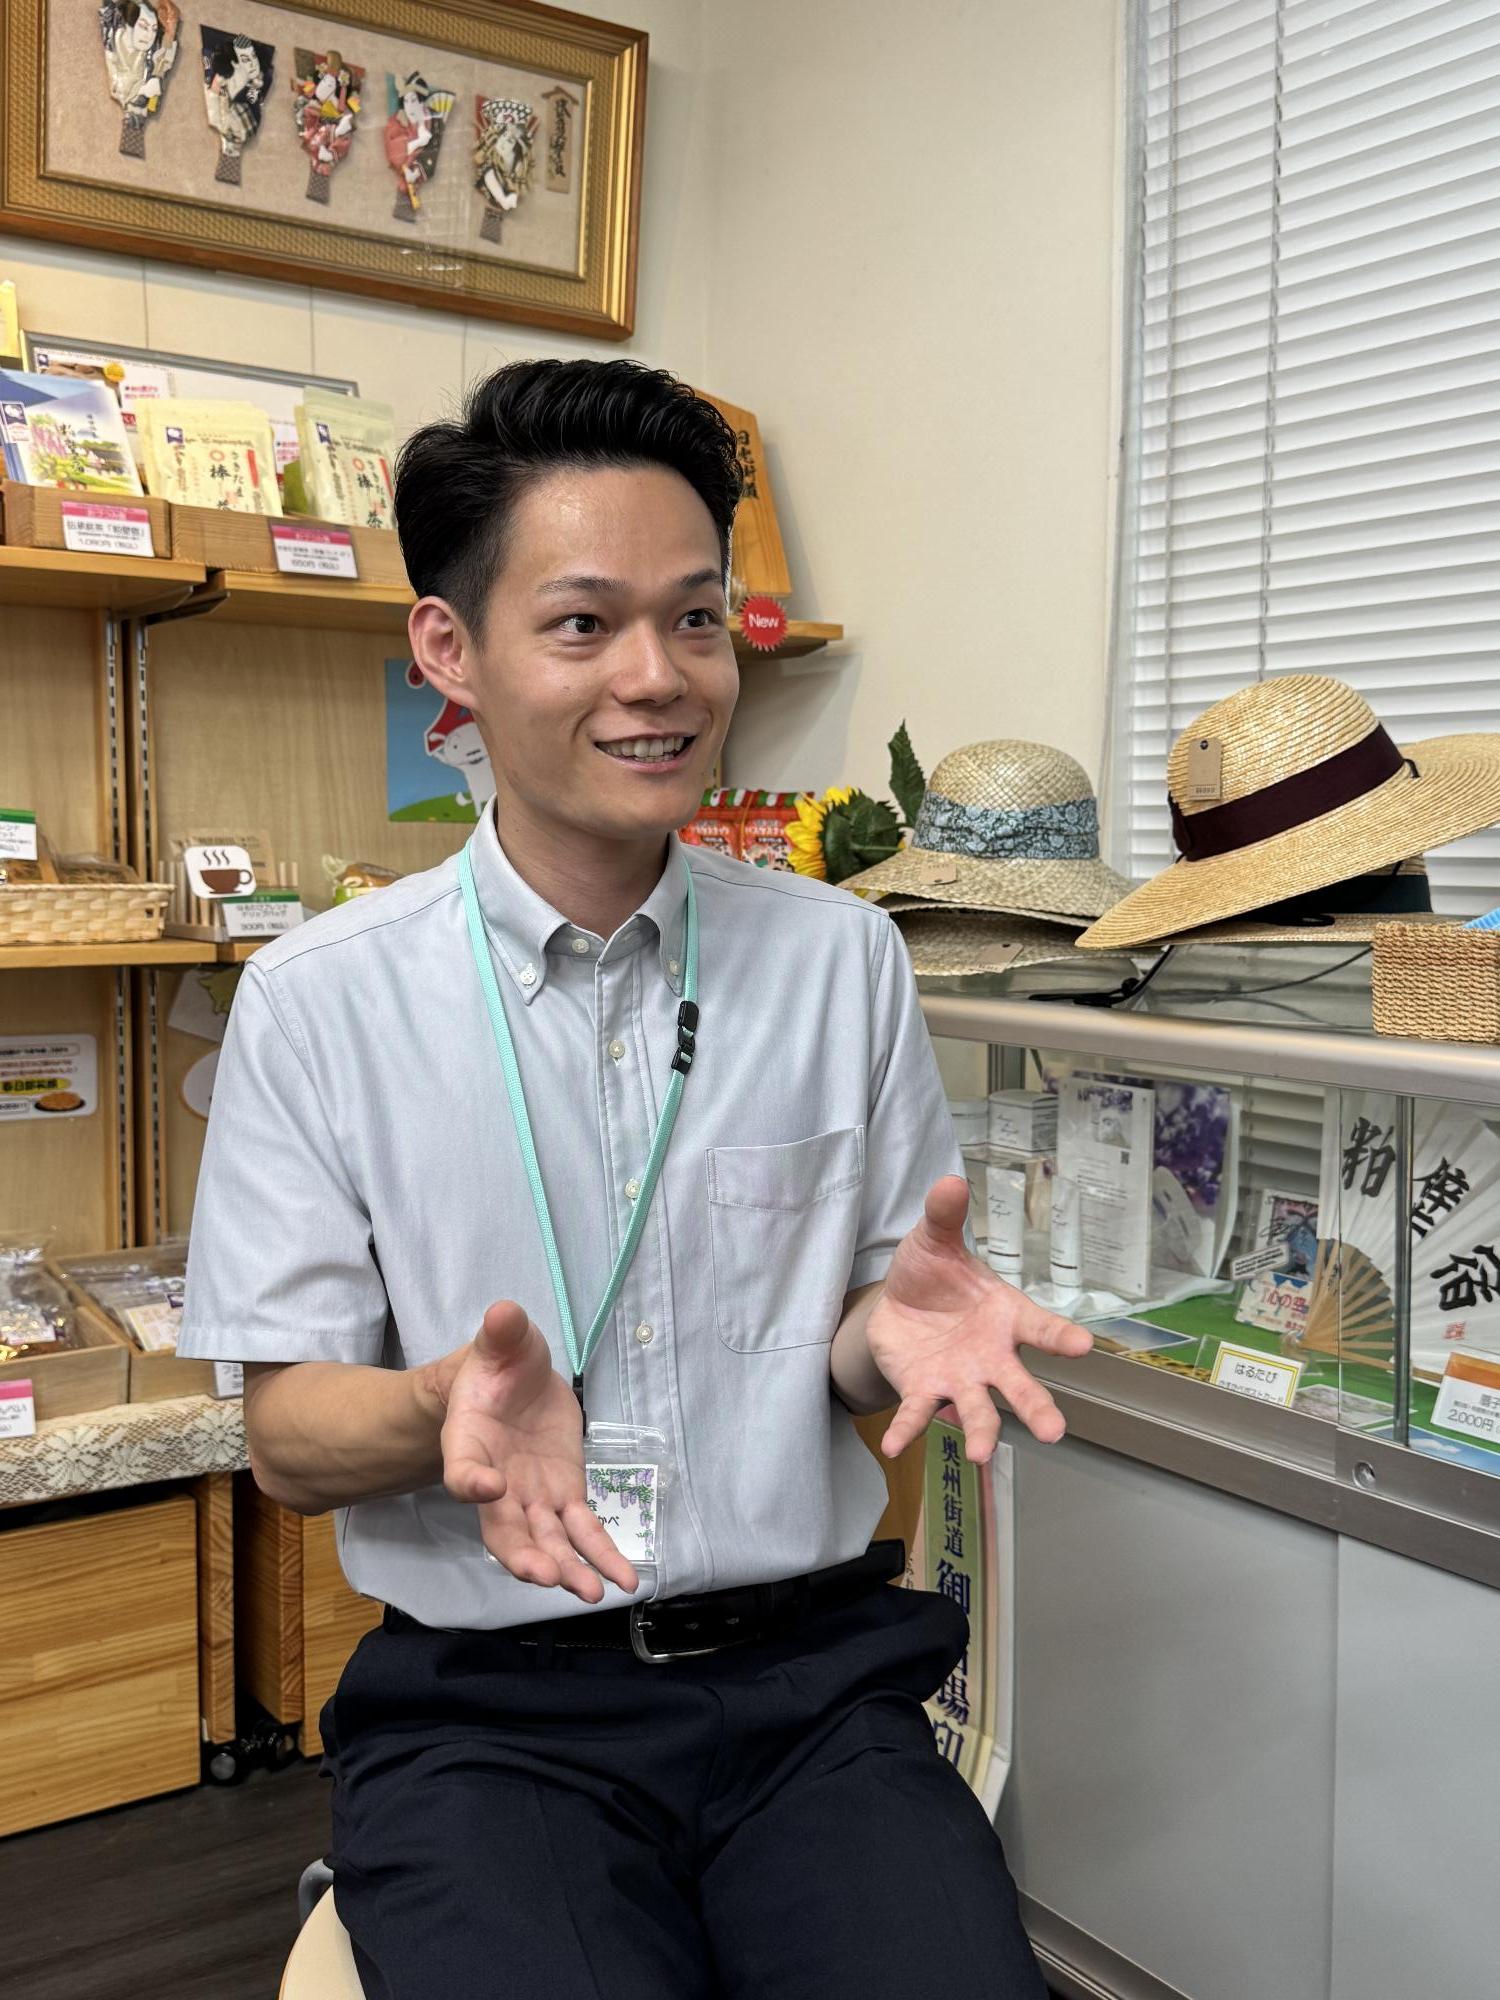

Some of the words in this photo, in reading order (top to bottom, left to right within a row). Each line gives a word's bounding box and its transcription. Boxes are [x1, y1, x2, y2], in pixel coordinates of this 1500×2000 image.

[748, 613, 780, 629] New
[1234, 1361, 1278, 1384] はるたび
[941, 1434, 964, 1558] 奥州街道
